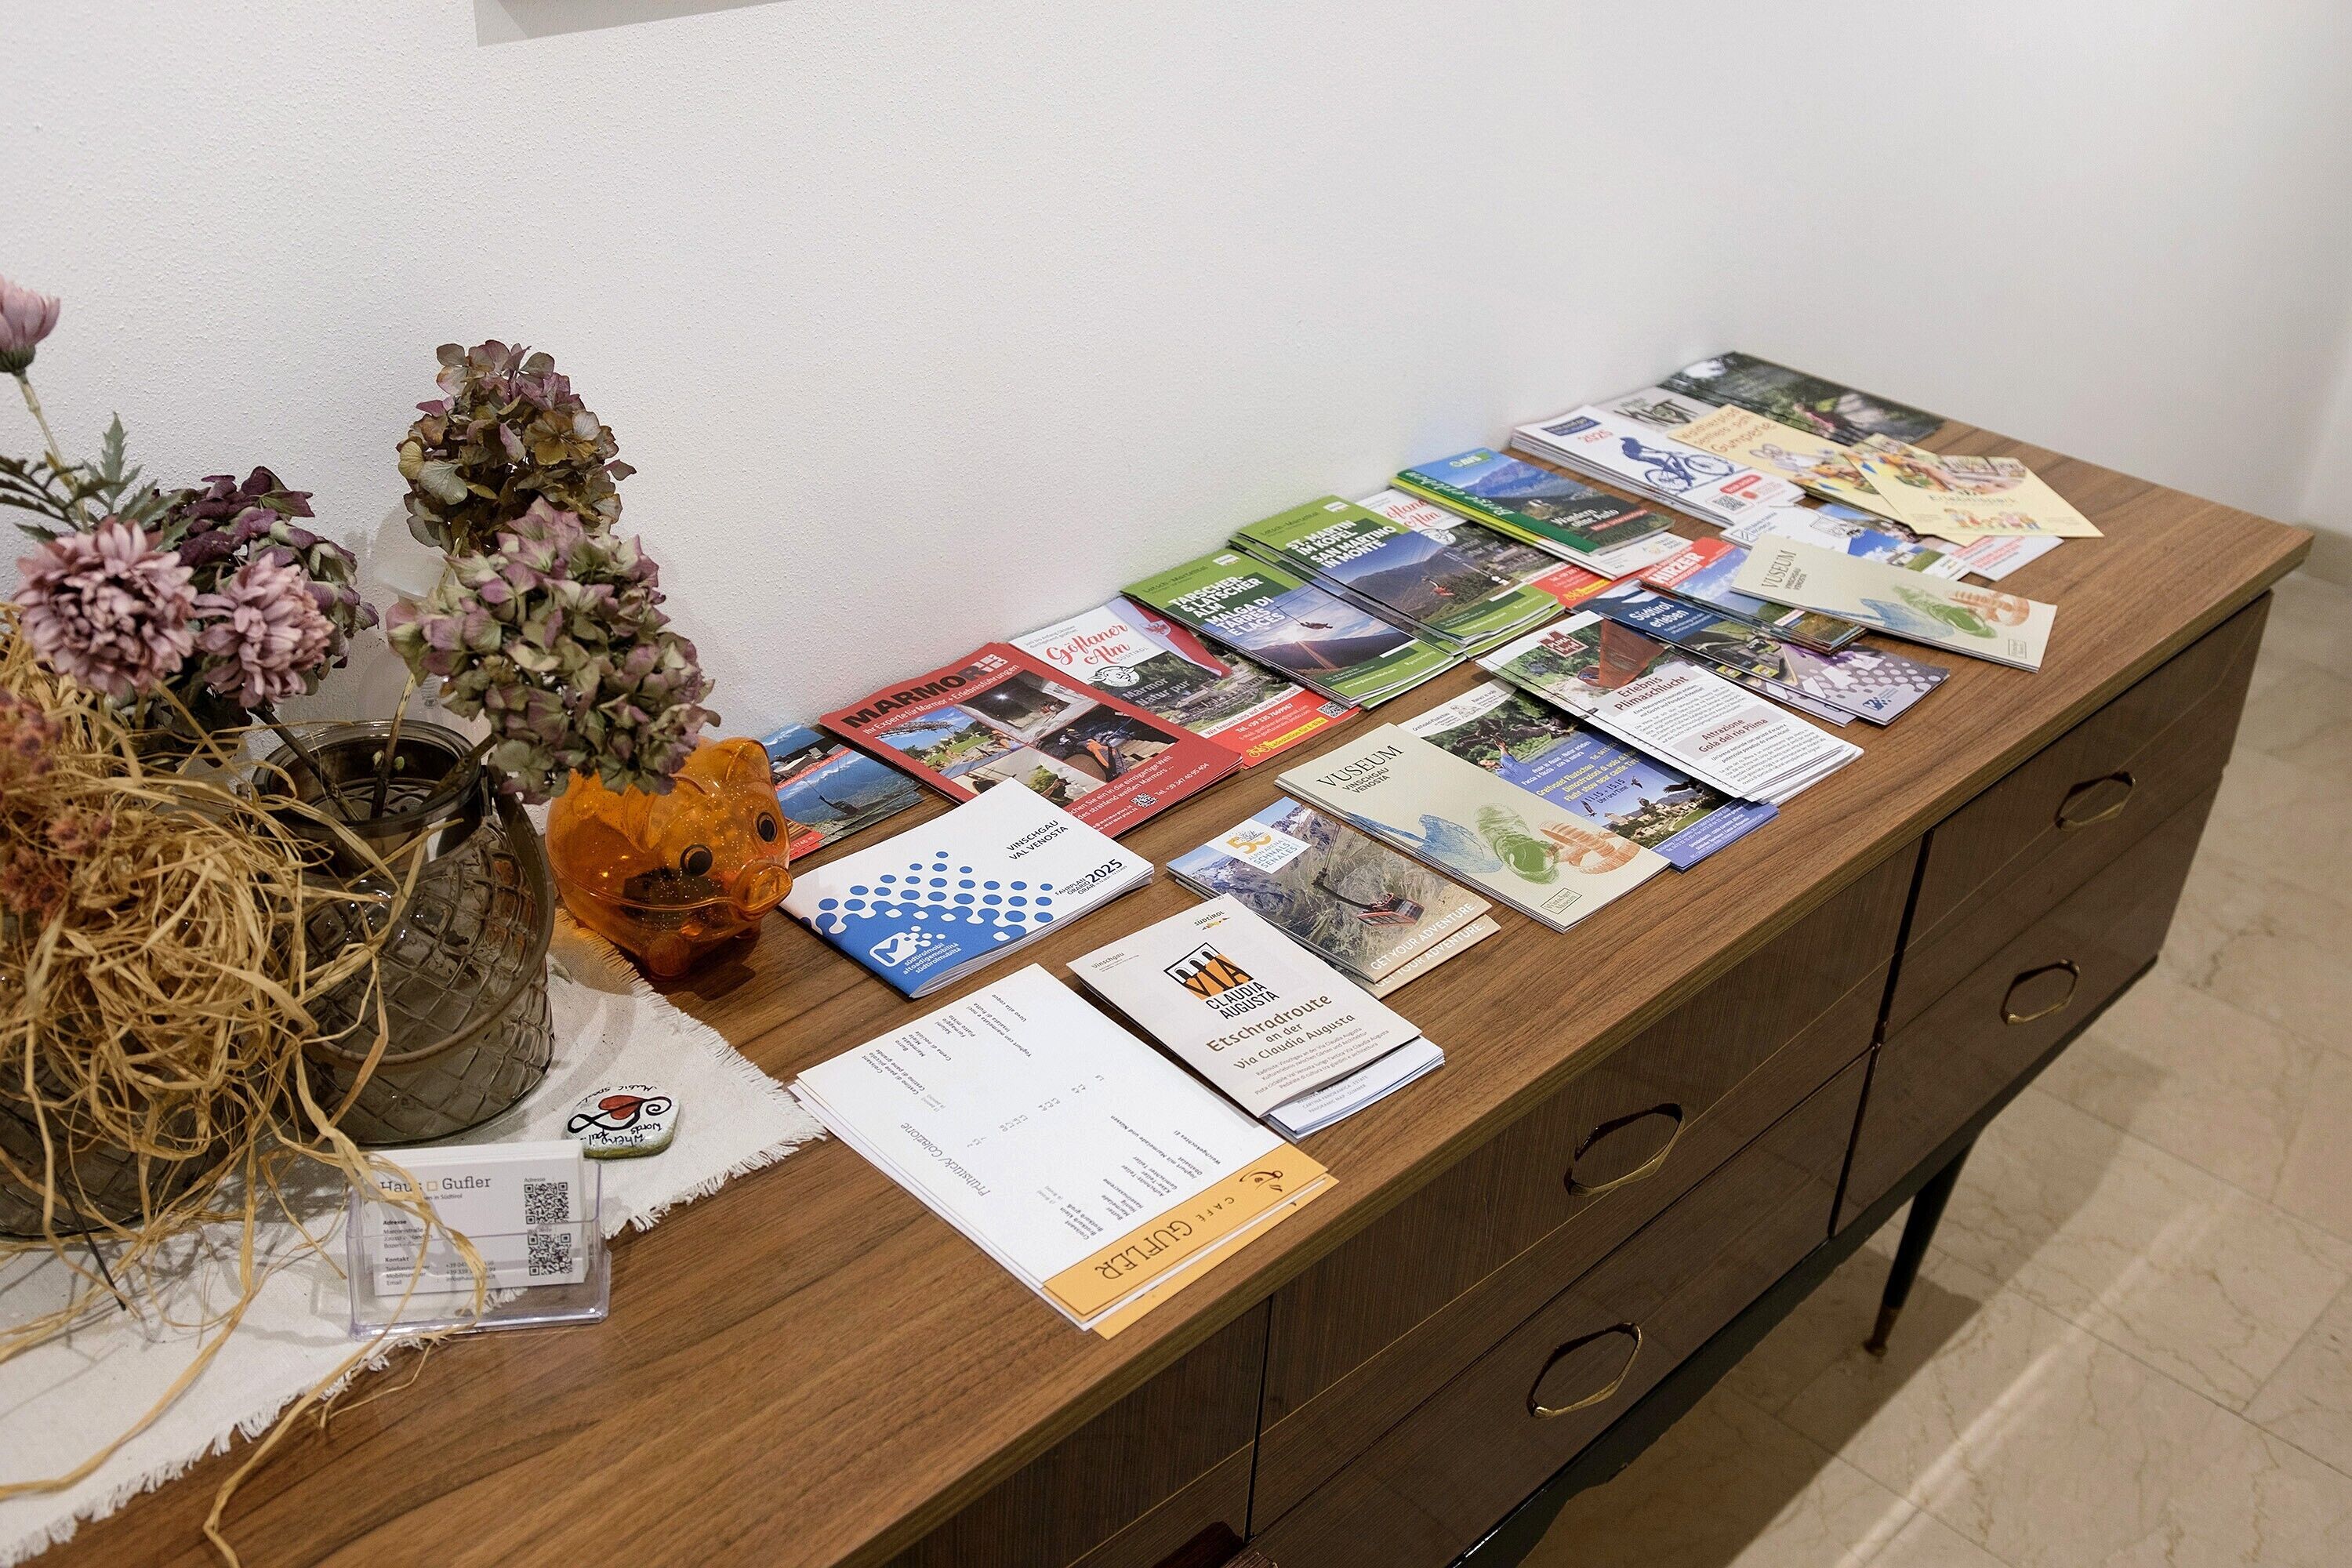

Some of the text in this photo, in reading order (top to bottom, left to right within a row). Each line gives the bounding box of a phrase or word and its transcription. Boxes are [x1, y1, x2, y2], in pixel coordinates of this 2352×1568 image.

[1285, 520, 1357, 551] ST. MARTIN
[1296, 530, 1359, 556] IM KOFEL
[1310, 525, 1397, 563] SAN MARTINO
[1320, 539, 1388, 568] IN MONTE
[1648, 552, 1705, 584] HIRZER
[1762, 550, 1796, 587] VUSEUM
[1168, 575, 1244, 607] TARSCHER-
[1192, 578, 1264, 608] LATSCHER
[1193, 602, 1226, 619] ALM
[1205, 596, 1275, 625] MALGA DI
[1216, 608, 1271, 631] TARRES
[1629, 601, 1674, 621] Südtirol
[1650, 609, 1690, 628] erleben
[1227, 612, 1286, 637] E LACES
[1046, 622, 1129, 666] Göflaner
[1083, 642, 1131, 665] Alm
[1116, 647, 1149, 663] SÜDTIROL
[841, 662, 989, 728] MARMOR
[862, 665, 1019, 735] Ihr Experte Marmor Erlebnisführungen
[1122, 677, 1169, 700] Marmor
[1135, 680, 1190, 706] Natur pur
[1614, 676, 1689, 711] Plimaschlucht
[1617, 677, 1663, 698] Erlebnis
[1215, 718, 1238, 732] freuen
[1269, 728, 1300, 748] Ladestation
[1699, 718, 1768, 753] Gola del rio Plima
[1701, 718, 1745, 741] Attrazione
[1316, 746, 1404, 786] VUSEUM
[1342, 768, 1389, 790] VINSCHGAU
[1562, 757, 1621, 793] Dimostrazioni volo
[1087, 797, 1098, 805] Sie
[1124, 764, 1157, 789] einzigartige
[1156, 755, 1173, 768] Welt
[1154, 788, 1166, 797] Tel.
[1175, 778, 1185, 788] 347
[1198, 763, 1210, 772] 404
[1352, 775, 1390, 793] VENOSTA
[1581, 775, 1611, 793] show near
[1609, 779, 1625, 789] 15.15
[1077, 768, 1168, 820] des strahlend weißen Marmors
[1006, 820, 1058, 851] VINSCHGAU
[1009, 826, 1069, 860] VAL VENOSTA
[1254, 843, 1290, 865] SCHNALS
[1261, 846, 1298, 869] SENALES
[1055, 858, 1123, 896] FAHRPLAN 2025
[1067, 880, 1091, 895] ORARIO
[1077, 884, 1096, 895] ORAR
[1371, 903, 1477, 971] GET YOUR ADVENTURE.
[904, 942, 945, 966] südtirolmobil
[1091, 952, 1125, 969] Vinschgau
[1375, 923, 1486, 988] GET YOUR ADVENTURE.
[1174, 949, 1254, 997] VIA
[1205, 982, 1268, 1011] CLAUDIA
[1219, 990, 1280, 1020] AUGUSTA
[935, 1021, 952, 1035] Salumi
[942, 1018, 966, 1038] Formaggio
[948, 1014, 976, 1037] Piatto misto
[973, 1003, 1010, 1033] Insalata frutta
[1014, 1012, 1026, 1022] Uovo
[1206, 994, 1333, 1052] Etschradroute
[908, 1033, 921, 1045] Miele
[966, 1006, 1033, 1058] Yoghurt marmelata noci
[1233, 1014, 1356, 1070] Via Claudia Augusta
[1265, 1023, 1304, 1044] an der
[895, 1040, 909, 1052] Burro
[902, 1036, 926, 1057] Marmelata
[936, 1047, 952, 1062] Crema
[862, 1055, 883, 1074] Croissant
[868, 1052, 920, 1095] Cestino pane piccolo
[875, 1049, 925, 1091] Cestino pane grande
[899, 1122, 942, 1158] Colazione
[1110, 1115, 1197, 1180] Joghurt Marmelade Nüssen
[1180, 1134, 1221, 1166] Weichgekochtes
[937, 1157, 991, 1198] Frühstück/
[1132, 1156, 1178, 1190] Gemischter Teller
[1178, 1156, 1203, 1175] Obstsalat
[442, 1176, 491, 1190] Gufler
[1102, 1178, 1144, 1209] Haselnusscreme
[1120, 1164, 1164, 1197] Aufschnitt-Teller
[1141, 1171, 1171, 1194] Käse-Teller
[1100, 1194, 1131, 1217] Marmelade
[1105, 1207, 1123, 1221] Butter
[1120, 1200, 1137, 1214] Honig
[1059, 1207, 1097, 1236] Brotkorb klein
[1064, 1221, 1090, 1240] Croissant
[1080, 1213, 1104, 1232] Brotkorb
[1094, 1220, 1192, 1279] GUFLER
